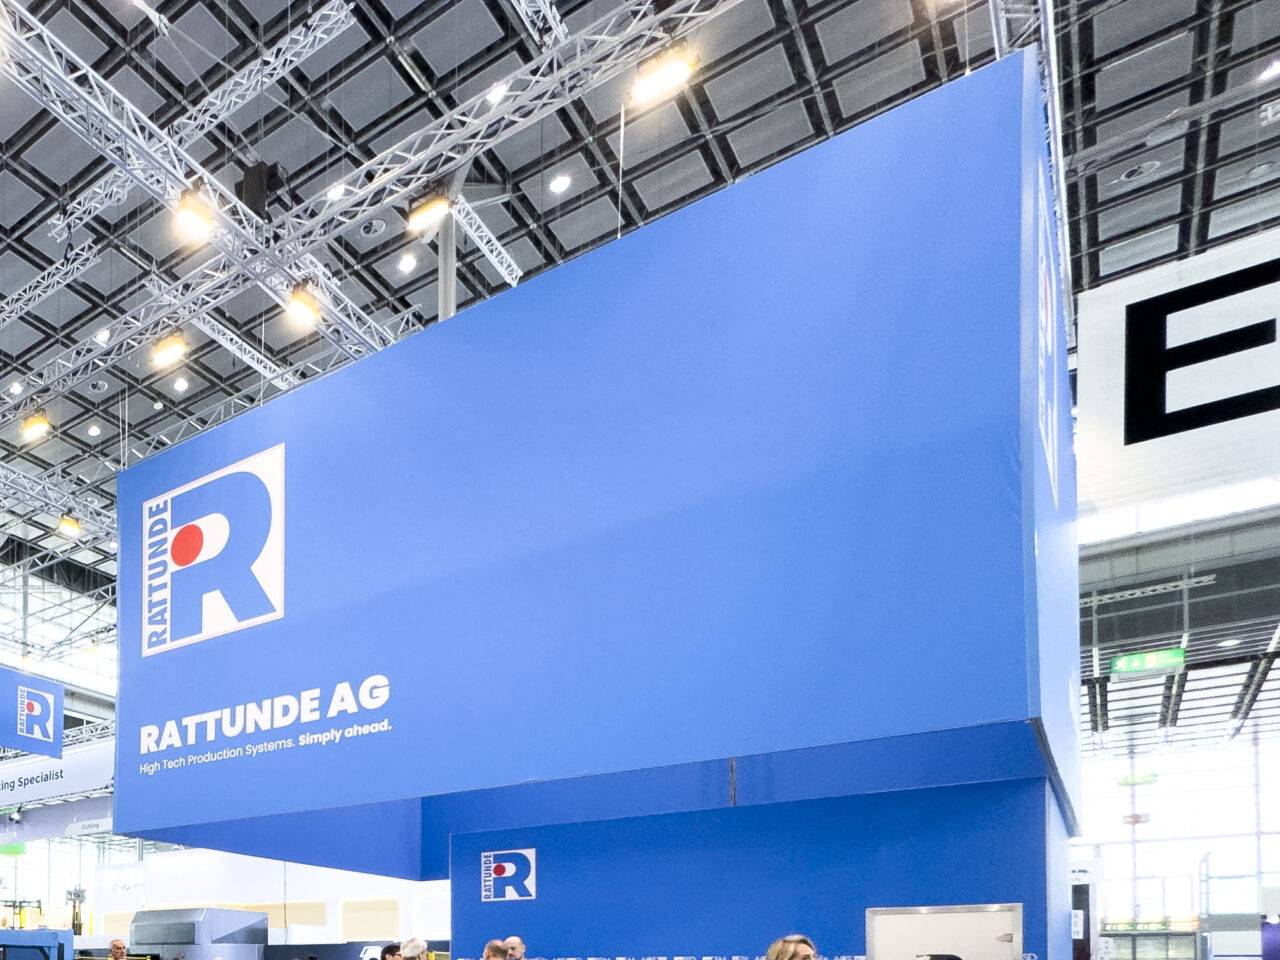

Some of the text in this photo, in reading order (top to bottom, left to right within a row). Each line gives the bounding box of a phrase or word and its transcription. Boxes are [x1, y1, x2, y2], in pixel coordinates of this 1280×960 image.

[147, 499, 169, 650] RATTUNDE
[170, 471, 277, 643] R
[139, 718, 392, 776] High Tech Production Systems. Simply ahead.
[140, 674, 390, 755] RATTUNDE AG
[17, 768, 64, 789] Specialist
[483, 853, 492, 900] RATTUNDE
